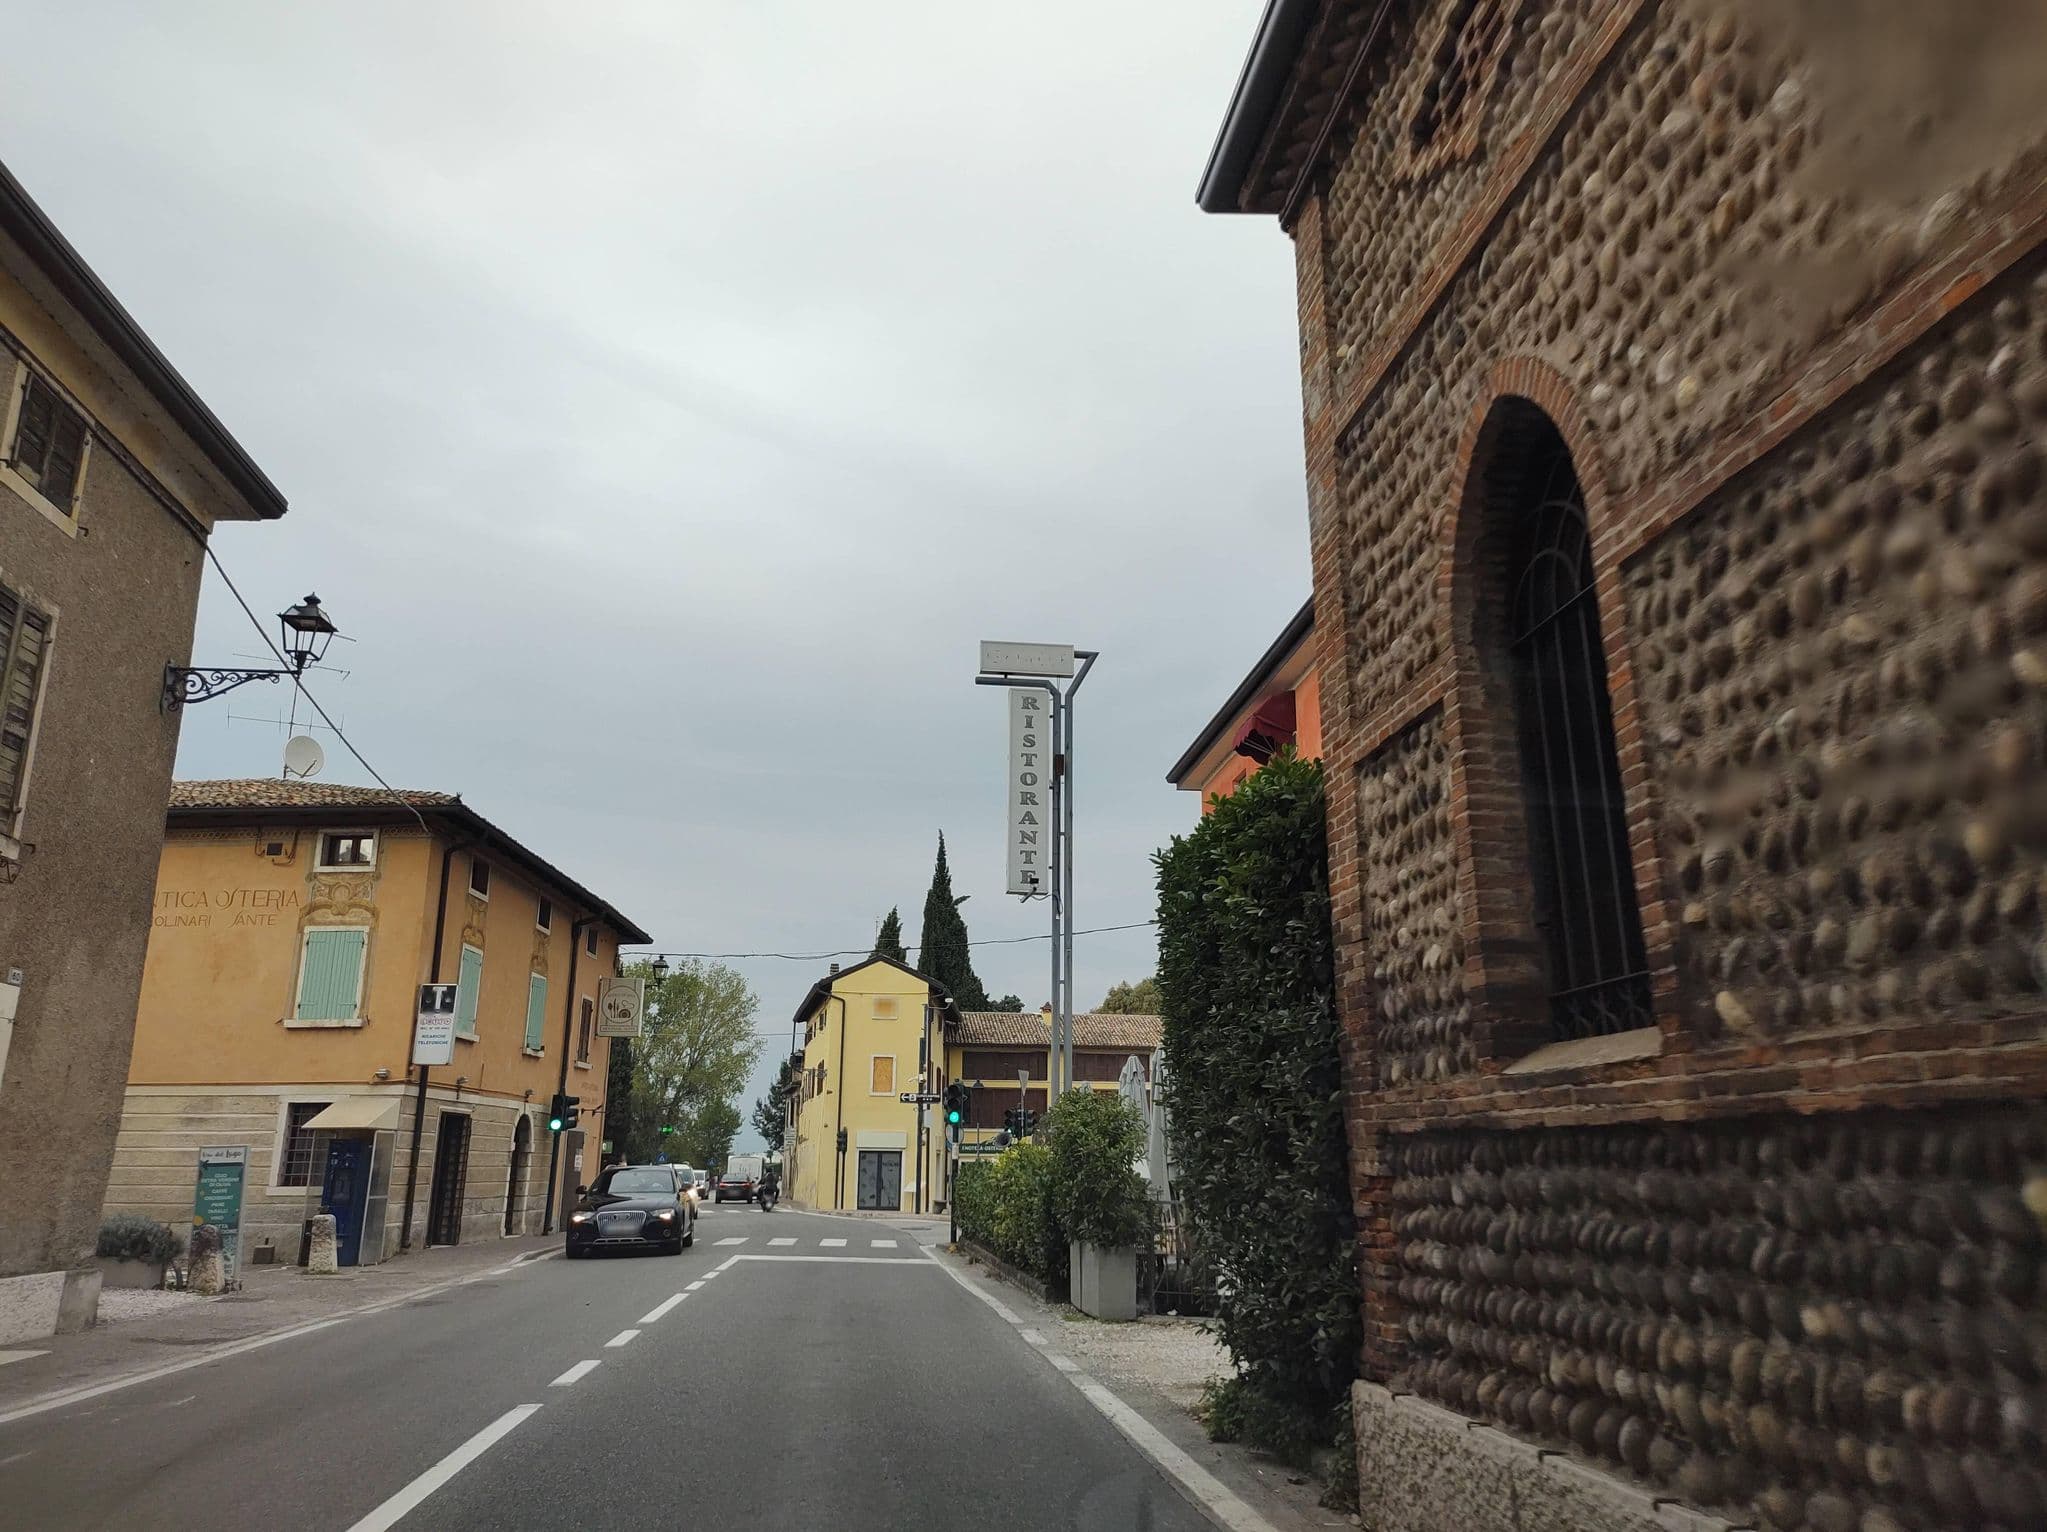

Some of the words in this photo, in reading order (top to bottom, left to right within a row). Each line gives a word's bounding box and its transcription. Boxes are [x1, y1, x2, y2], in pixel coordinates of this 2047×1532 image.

[1018, 695, 1040, 885] RISTORANTE
[215, 888, 299, 912] OSTERIA
[153, 914, 212, 928] OLINARI
[229, 911, 278, 928] SANTE
